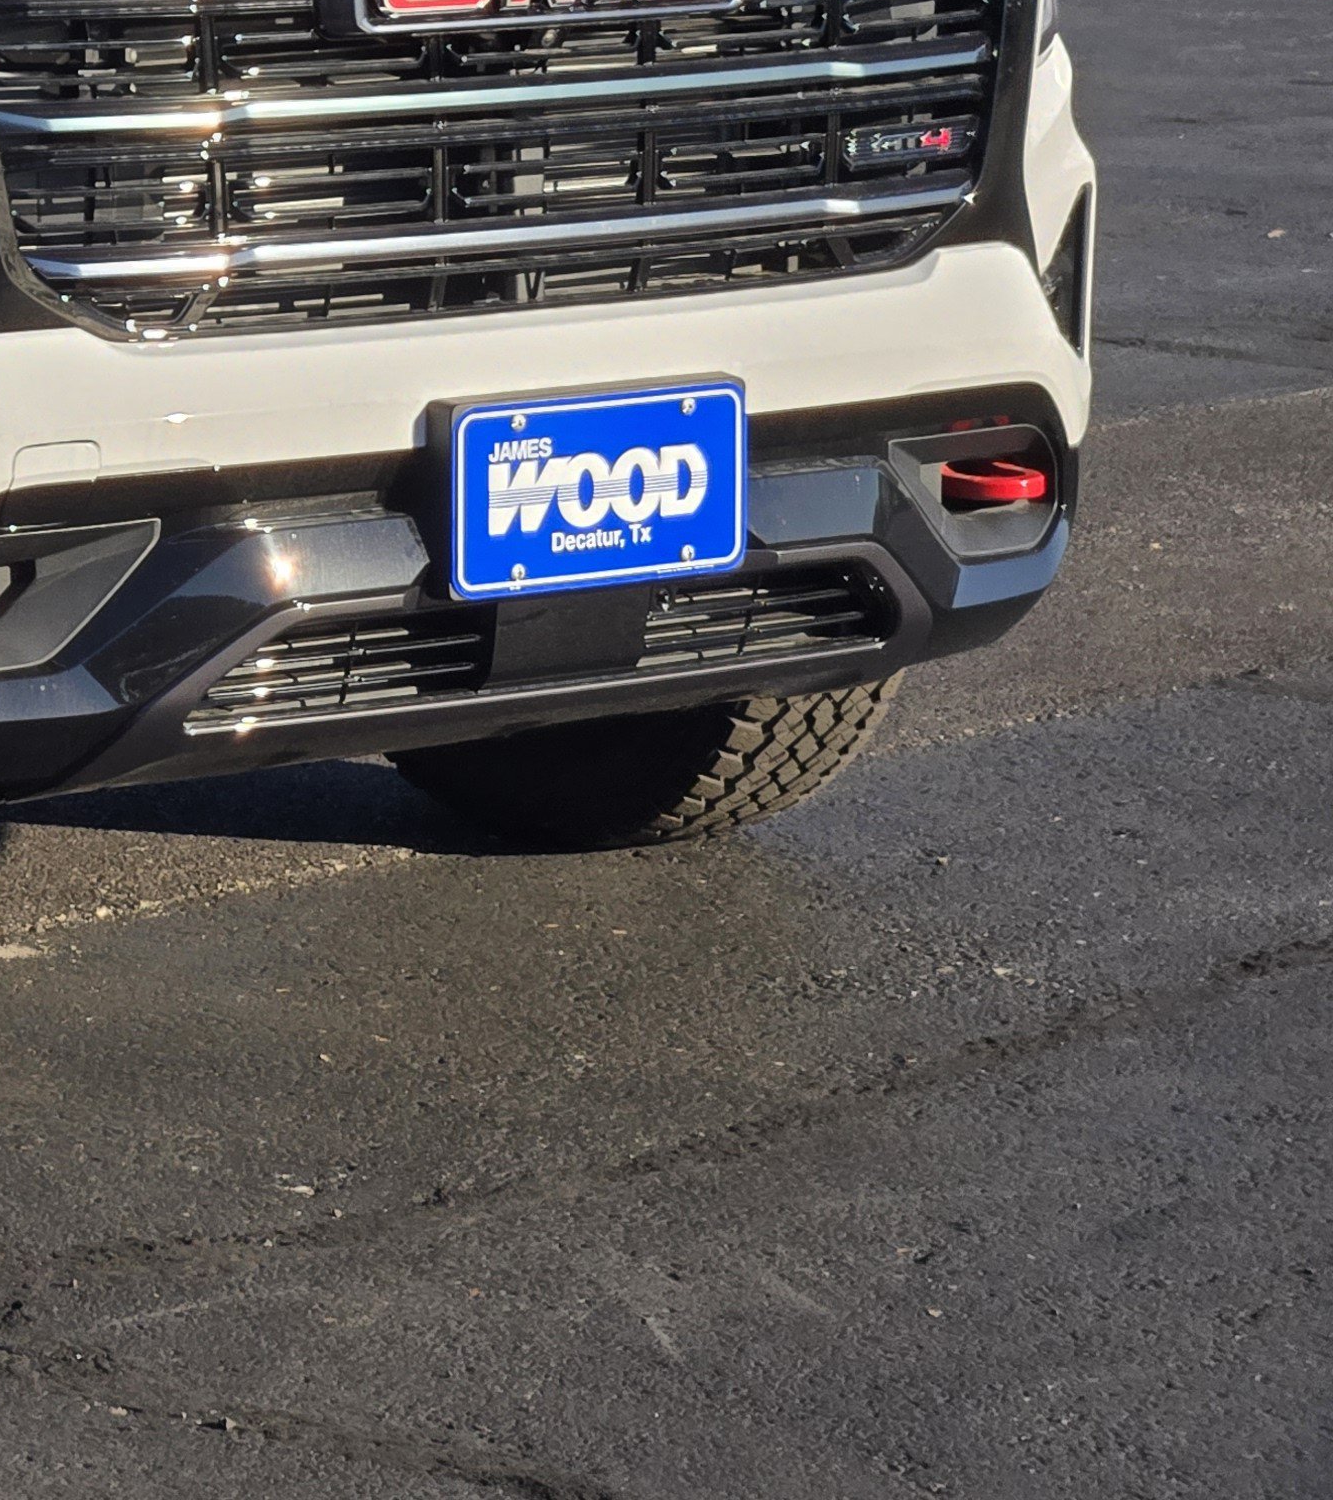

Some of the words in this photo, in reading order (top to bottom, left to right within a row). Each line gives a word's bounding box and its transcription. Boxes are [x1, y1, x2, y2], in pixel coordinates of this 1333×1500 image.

[489, 437, 552, 463] JAMES
[488, 443, 708, 536] WOOD
[551, 528, 625, 553] Decatur,
[629, 523, 652, 544] Tx
